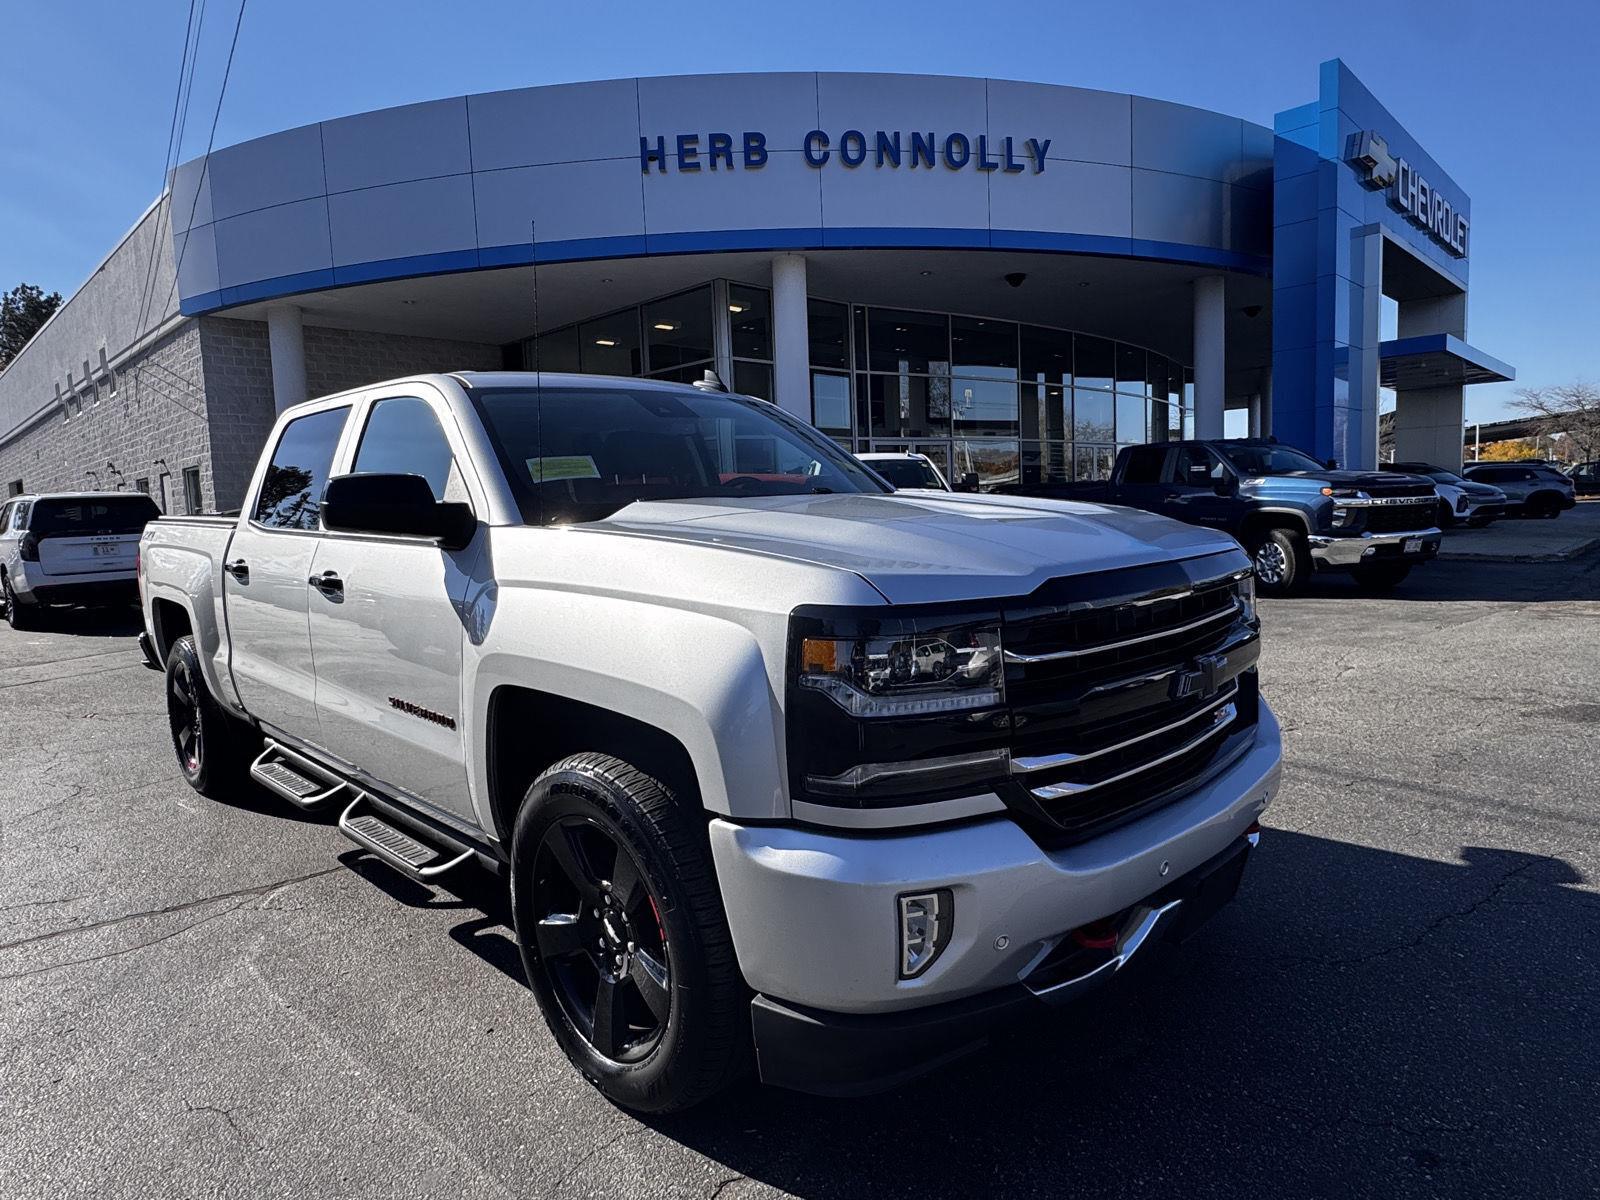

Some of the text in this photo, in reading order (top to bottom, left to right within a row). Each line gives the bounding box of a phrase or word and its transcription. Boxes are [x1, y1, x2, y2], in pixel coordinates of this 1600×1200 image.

[640, 130, 1052, 174] HERB CONNOLLY
[1397, 157, 1469, 259] CHEVROLET
